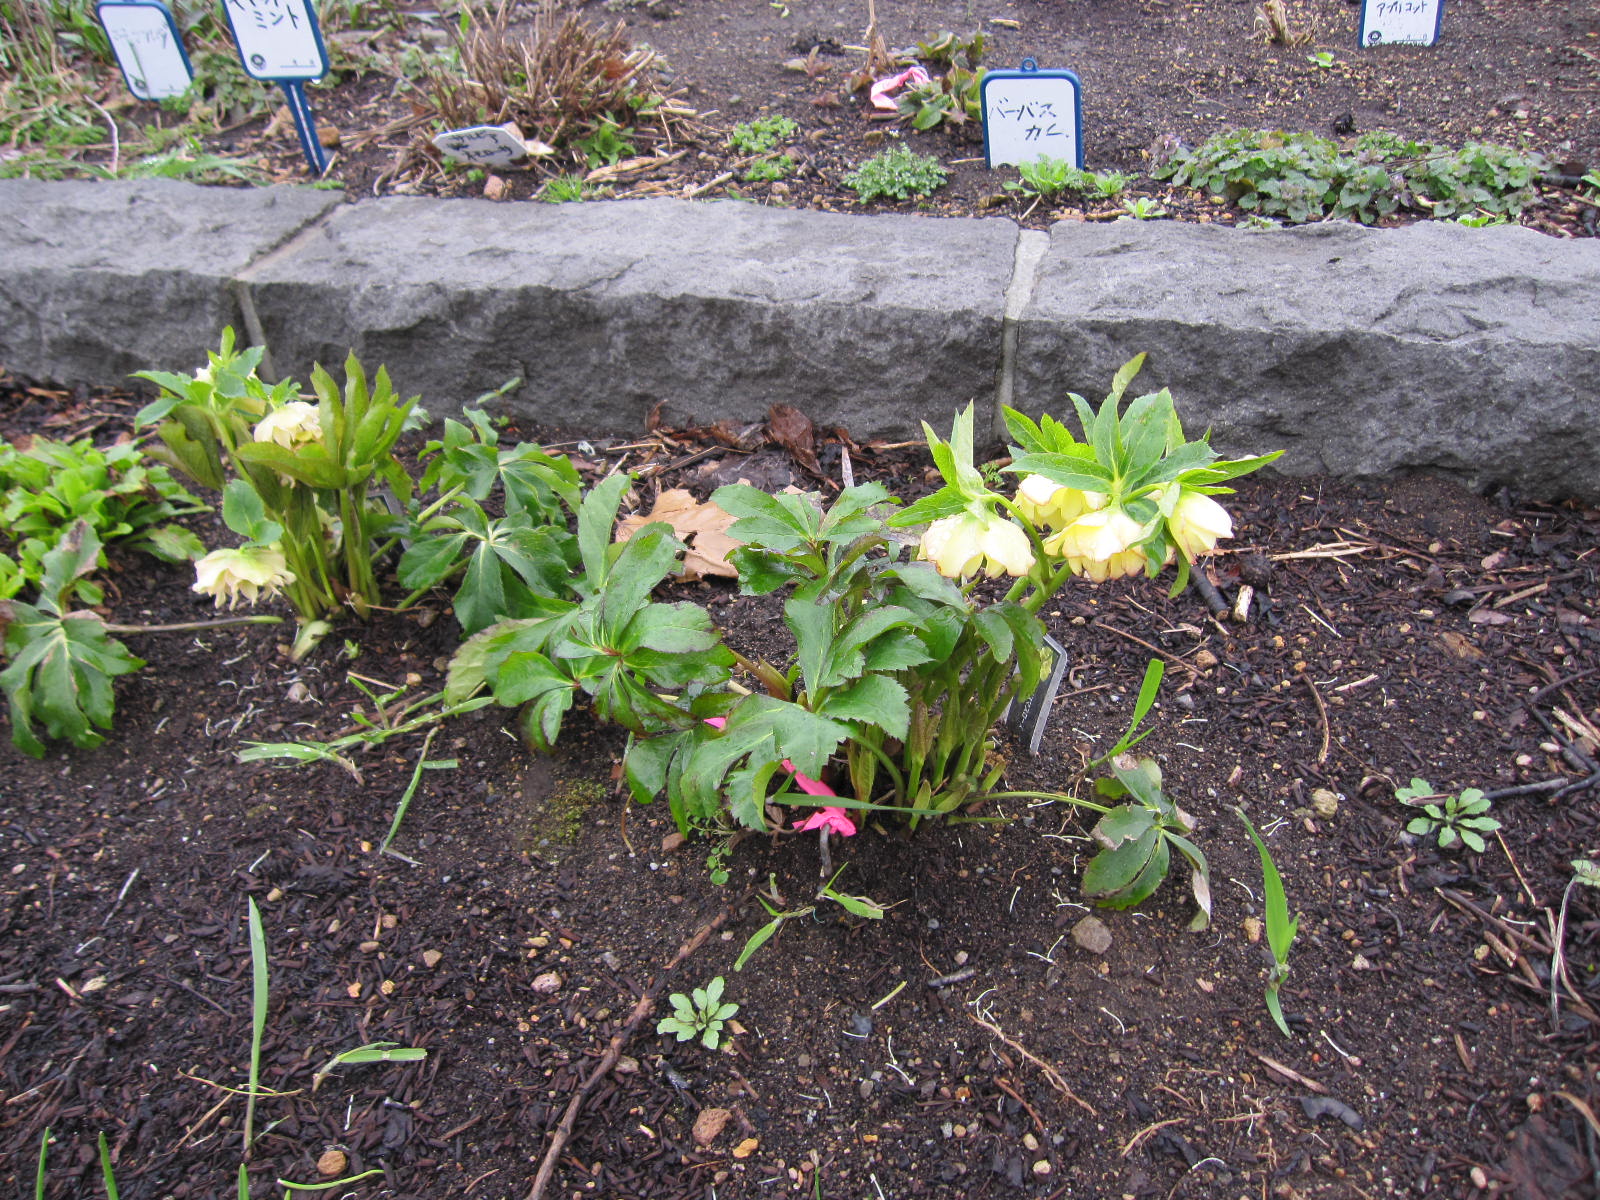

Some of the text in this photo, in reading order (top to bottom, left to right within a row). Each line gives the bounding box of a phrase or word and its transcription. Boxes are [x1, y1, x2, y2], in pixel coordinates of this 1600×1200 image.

[253, 4, 299, 30] ミント
[988, 96, 1057, 121] バーバス
